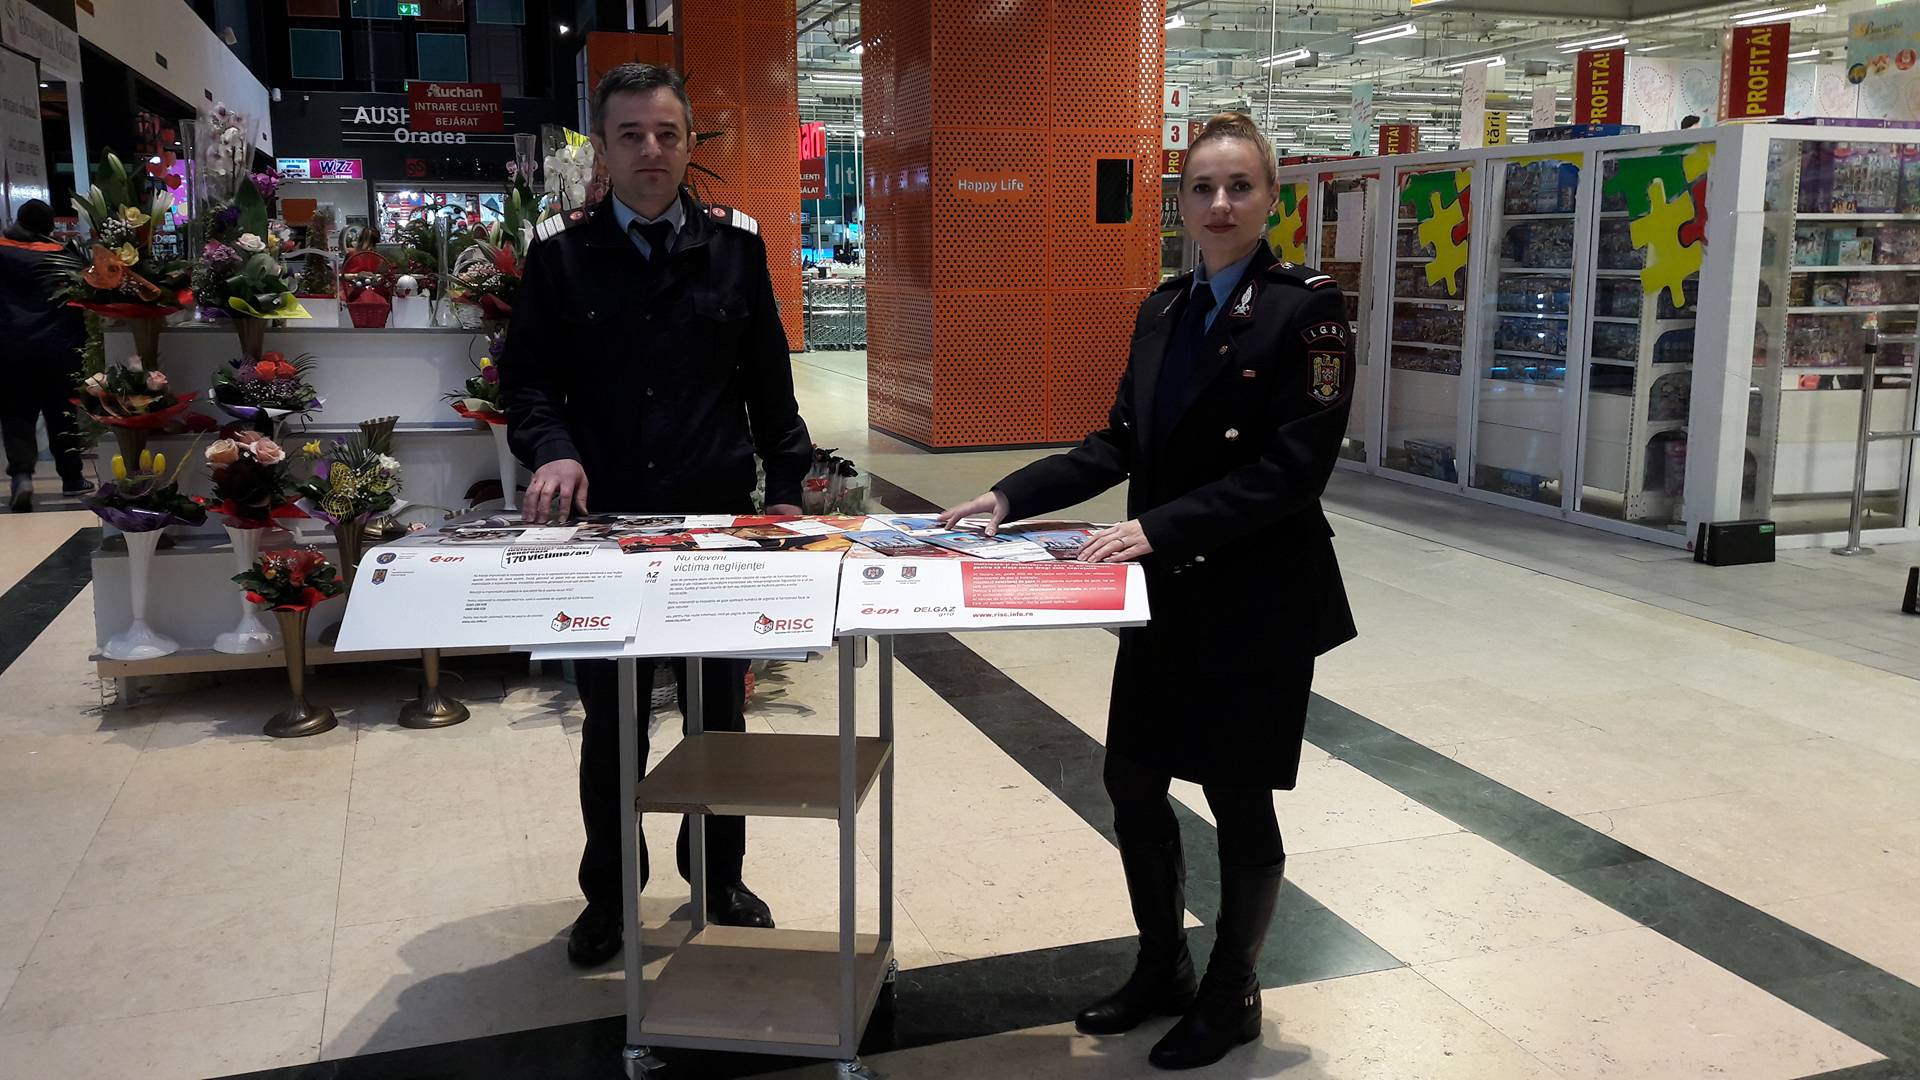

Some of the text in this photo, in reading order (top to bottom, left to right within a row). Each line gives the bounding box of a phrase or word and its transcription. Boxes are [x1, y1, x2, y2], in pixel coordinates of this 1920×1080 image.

[1745, 28, 1772, 115] PROFITĂ!
[427, 83, 483, 98] Auchan
[1171, 90, 1180, 107] 4
[415, 102, 458, 112] INTRARE
[394, 127, 466, 145] Oradea
[800, 122, 826, 160] an
[1171, 125, 1180, 142] 3
[1386, 127, 1399, 154] FITĂ!
[958, 178, 1024, 193] Happy Life
[505, 555, 527, 564] 170
[673, 562, 709, 572] victima
[913, 606, 956, 614] DELGAZ
[572, 616, 611, 628] RISC
[774, 618, 815, 631] RISC
